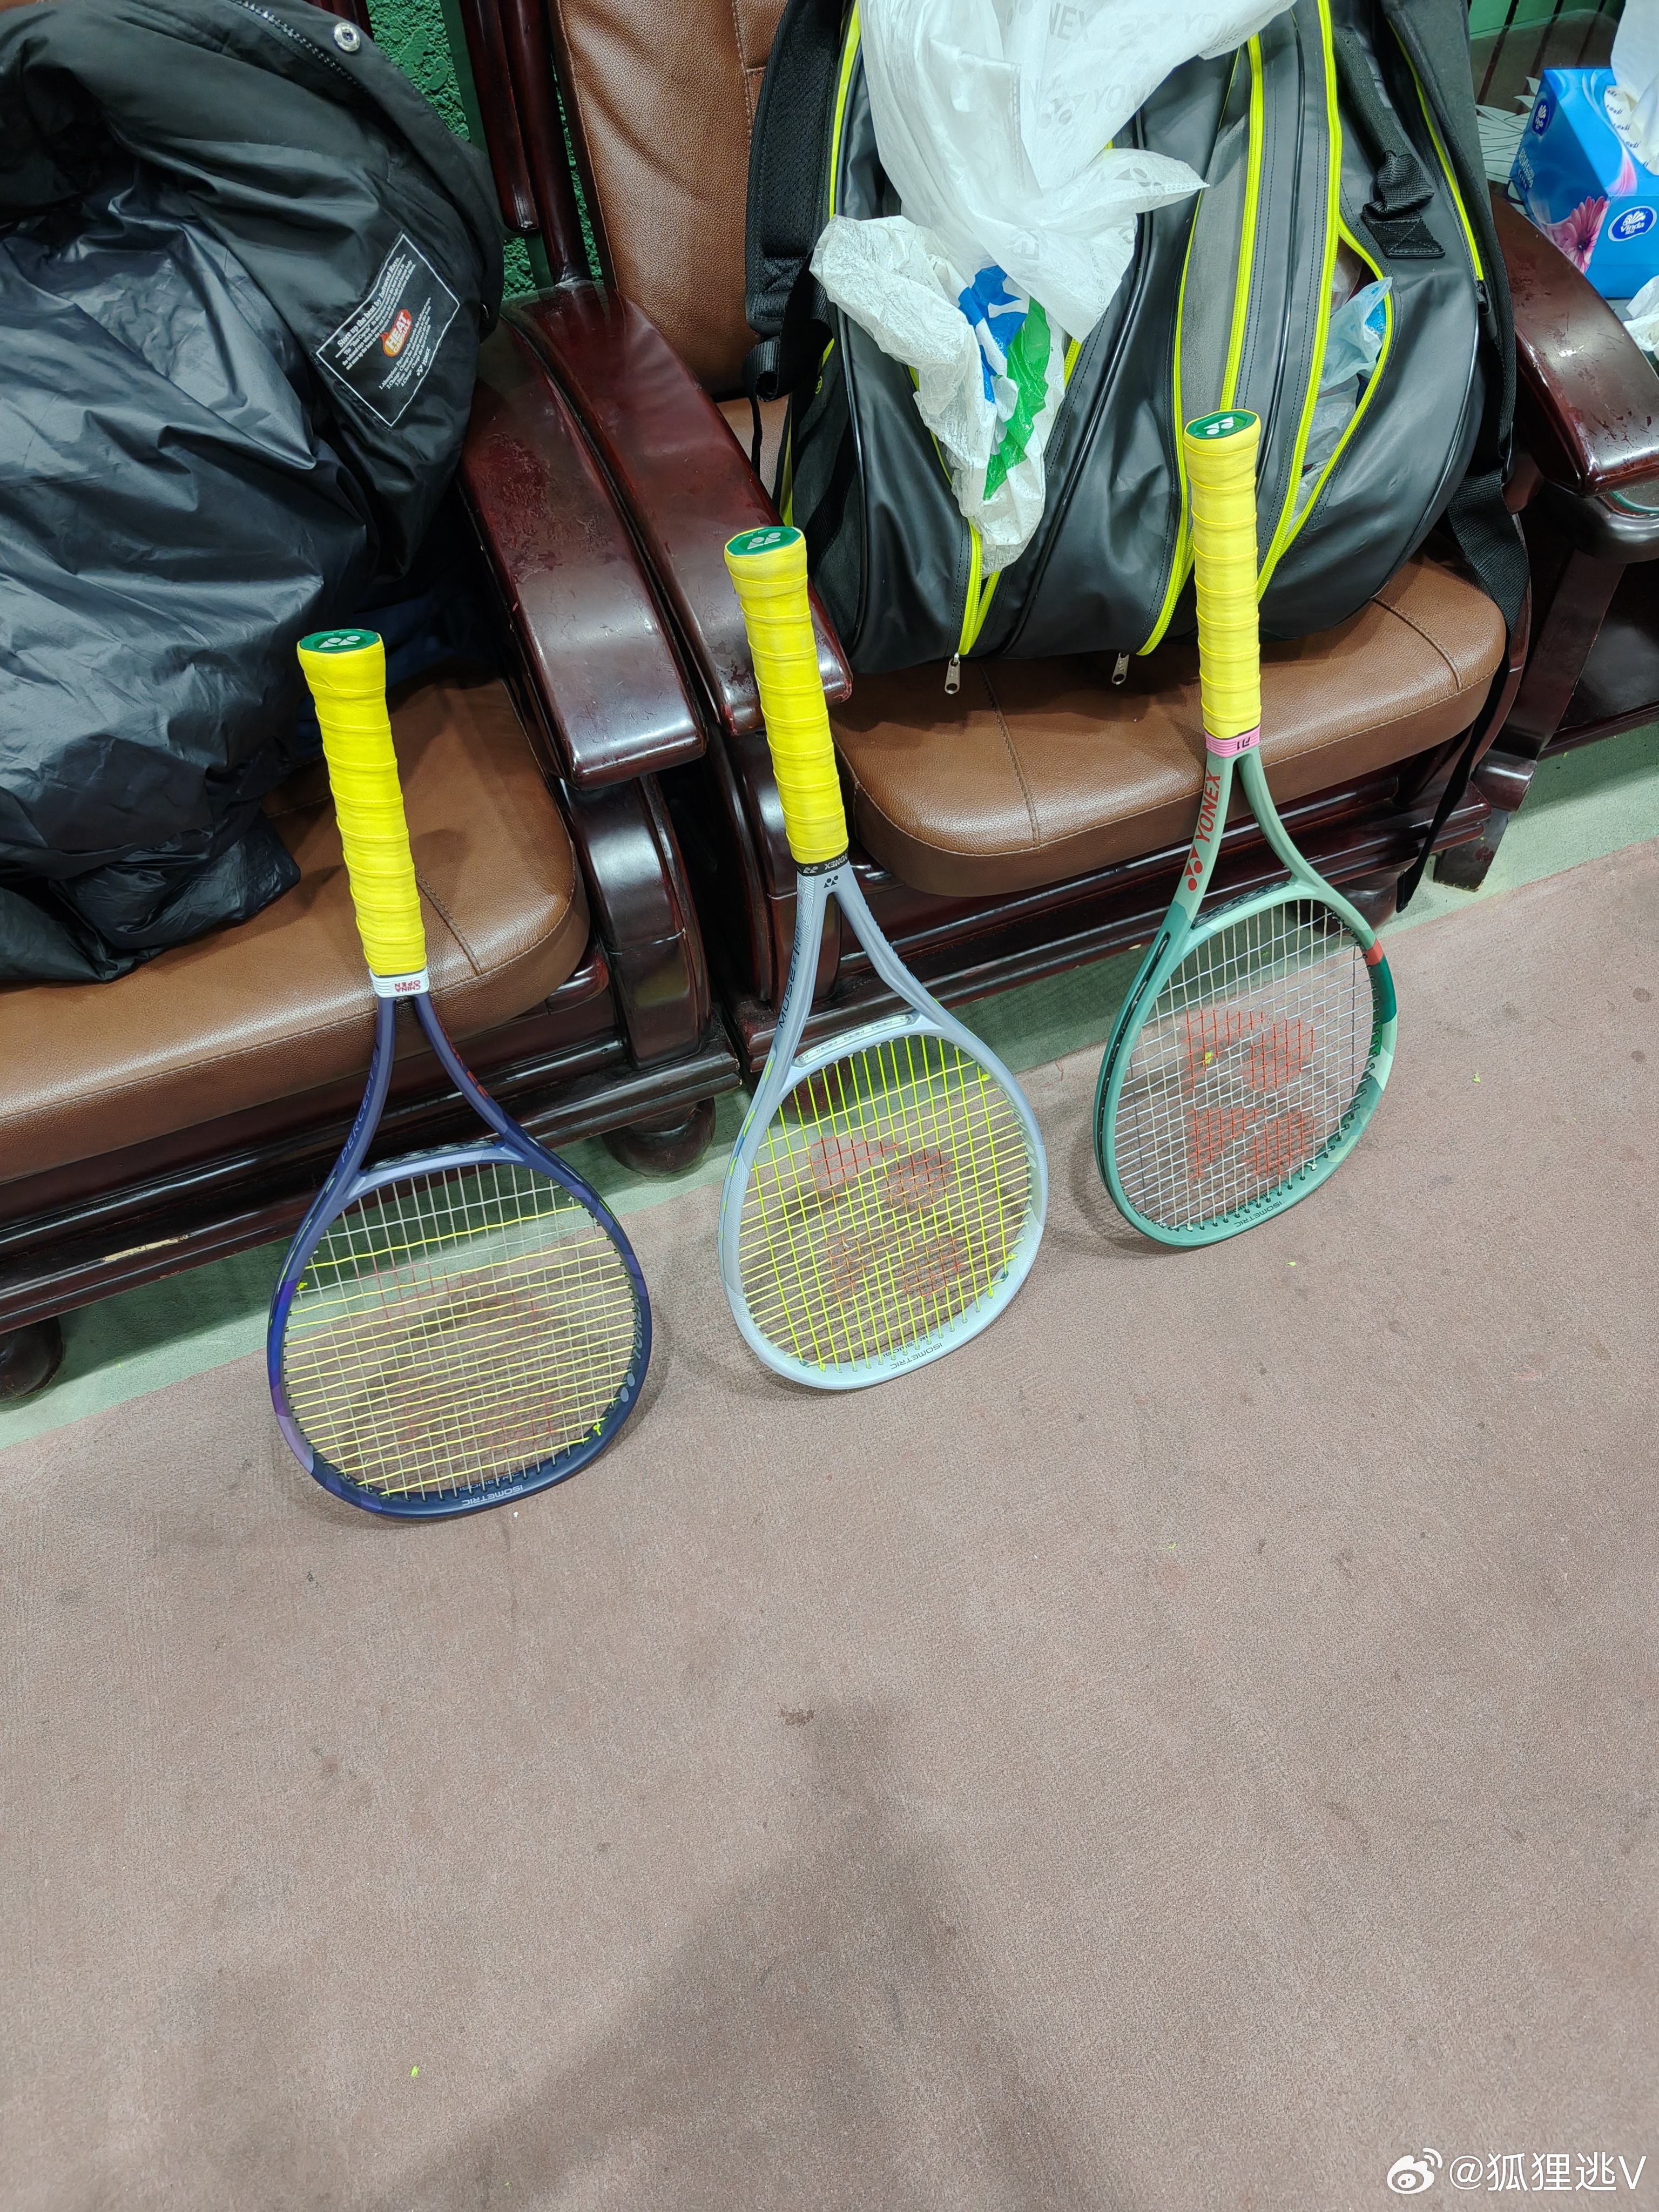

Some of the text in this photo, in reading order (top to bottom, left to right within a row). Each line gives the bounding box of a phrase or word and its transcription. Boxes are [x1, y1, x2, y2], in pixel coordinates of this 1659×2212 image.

[1620, 222, 1645, 232] Vinda
[337, 332, 352, 348] Store
[349, 325, 359, 334] up
[356, 317, 367, 327] the
[363, 305, 377, 319] heat
[373, 298, 382, 307] by
[379, 272, 392, 299] Infrared
[386, 312, 408, 349] HEAT
[393, 319, 411, 353] CAPSULE
[421, 346, 431, 366] YONEX
[1195, 767, 1221, 844] YONEX
[824, 853, 848, 871] YONEX
[395, 984, 421, 993] CHINA
[778, 966, 796, 1029] MUSE
[341, 1068, 374, 1163] PERCEPT
[1233, 1201, 1283, 1228] ISOMETRIC
[889, 1343, 943, 1370] ISOMETRIC
[462, 1485, 523, 1506] ISOMETRIC
